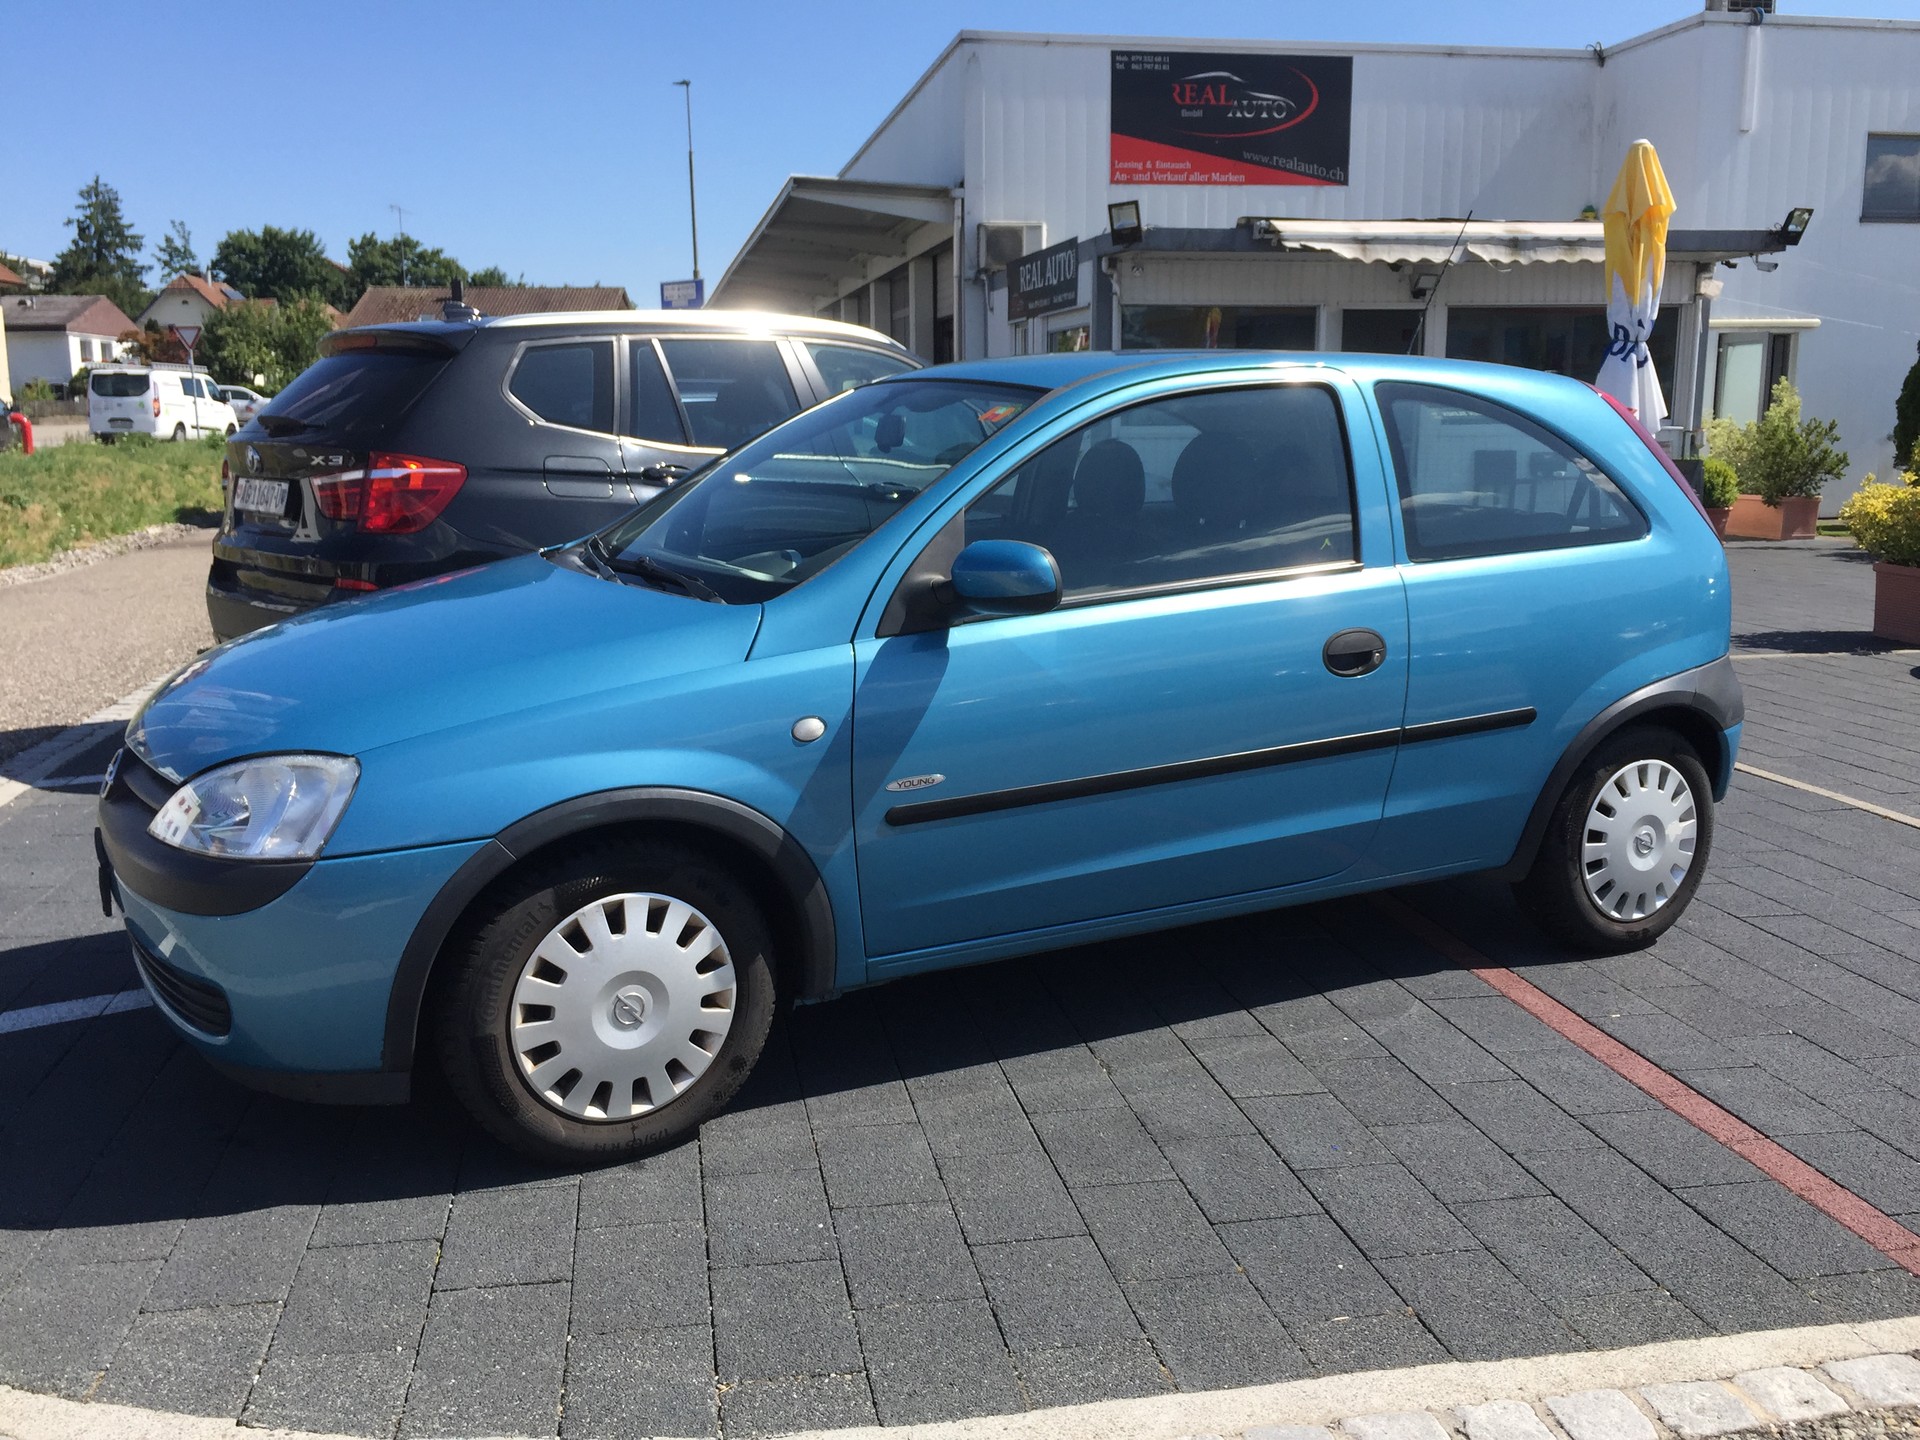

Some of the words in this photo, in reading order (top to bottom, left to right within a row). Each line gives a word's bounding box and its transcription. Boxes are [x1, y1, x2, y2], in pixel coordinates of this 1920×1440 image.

[1171, 83, 1234, 106] REAL
[1227, 99, 1288, 119] AUTO
[1114, 160, 1143, 170] Leasing
[1145, 160, 1153, 169] &
[1155, 160, 1192, 170] Eintausch
[1242, 150, 1345, 182] www.realauto.ch
[1114, 171, 1131, 181] An-
[1132, 172, 1151, 181] und
[1151, 171, 1187, 182] Verkauf
[1189, 172, 1209, 182] aller
[1211, 172, 1246, 182] Marken
[1020, 260, 1044, 293] REAL
[1045, 249, 1073, 286] AUTO
[310, 455, 344, 466] X3
[896, 776, 936, 789] YOUNG
